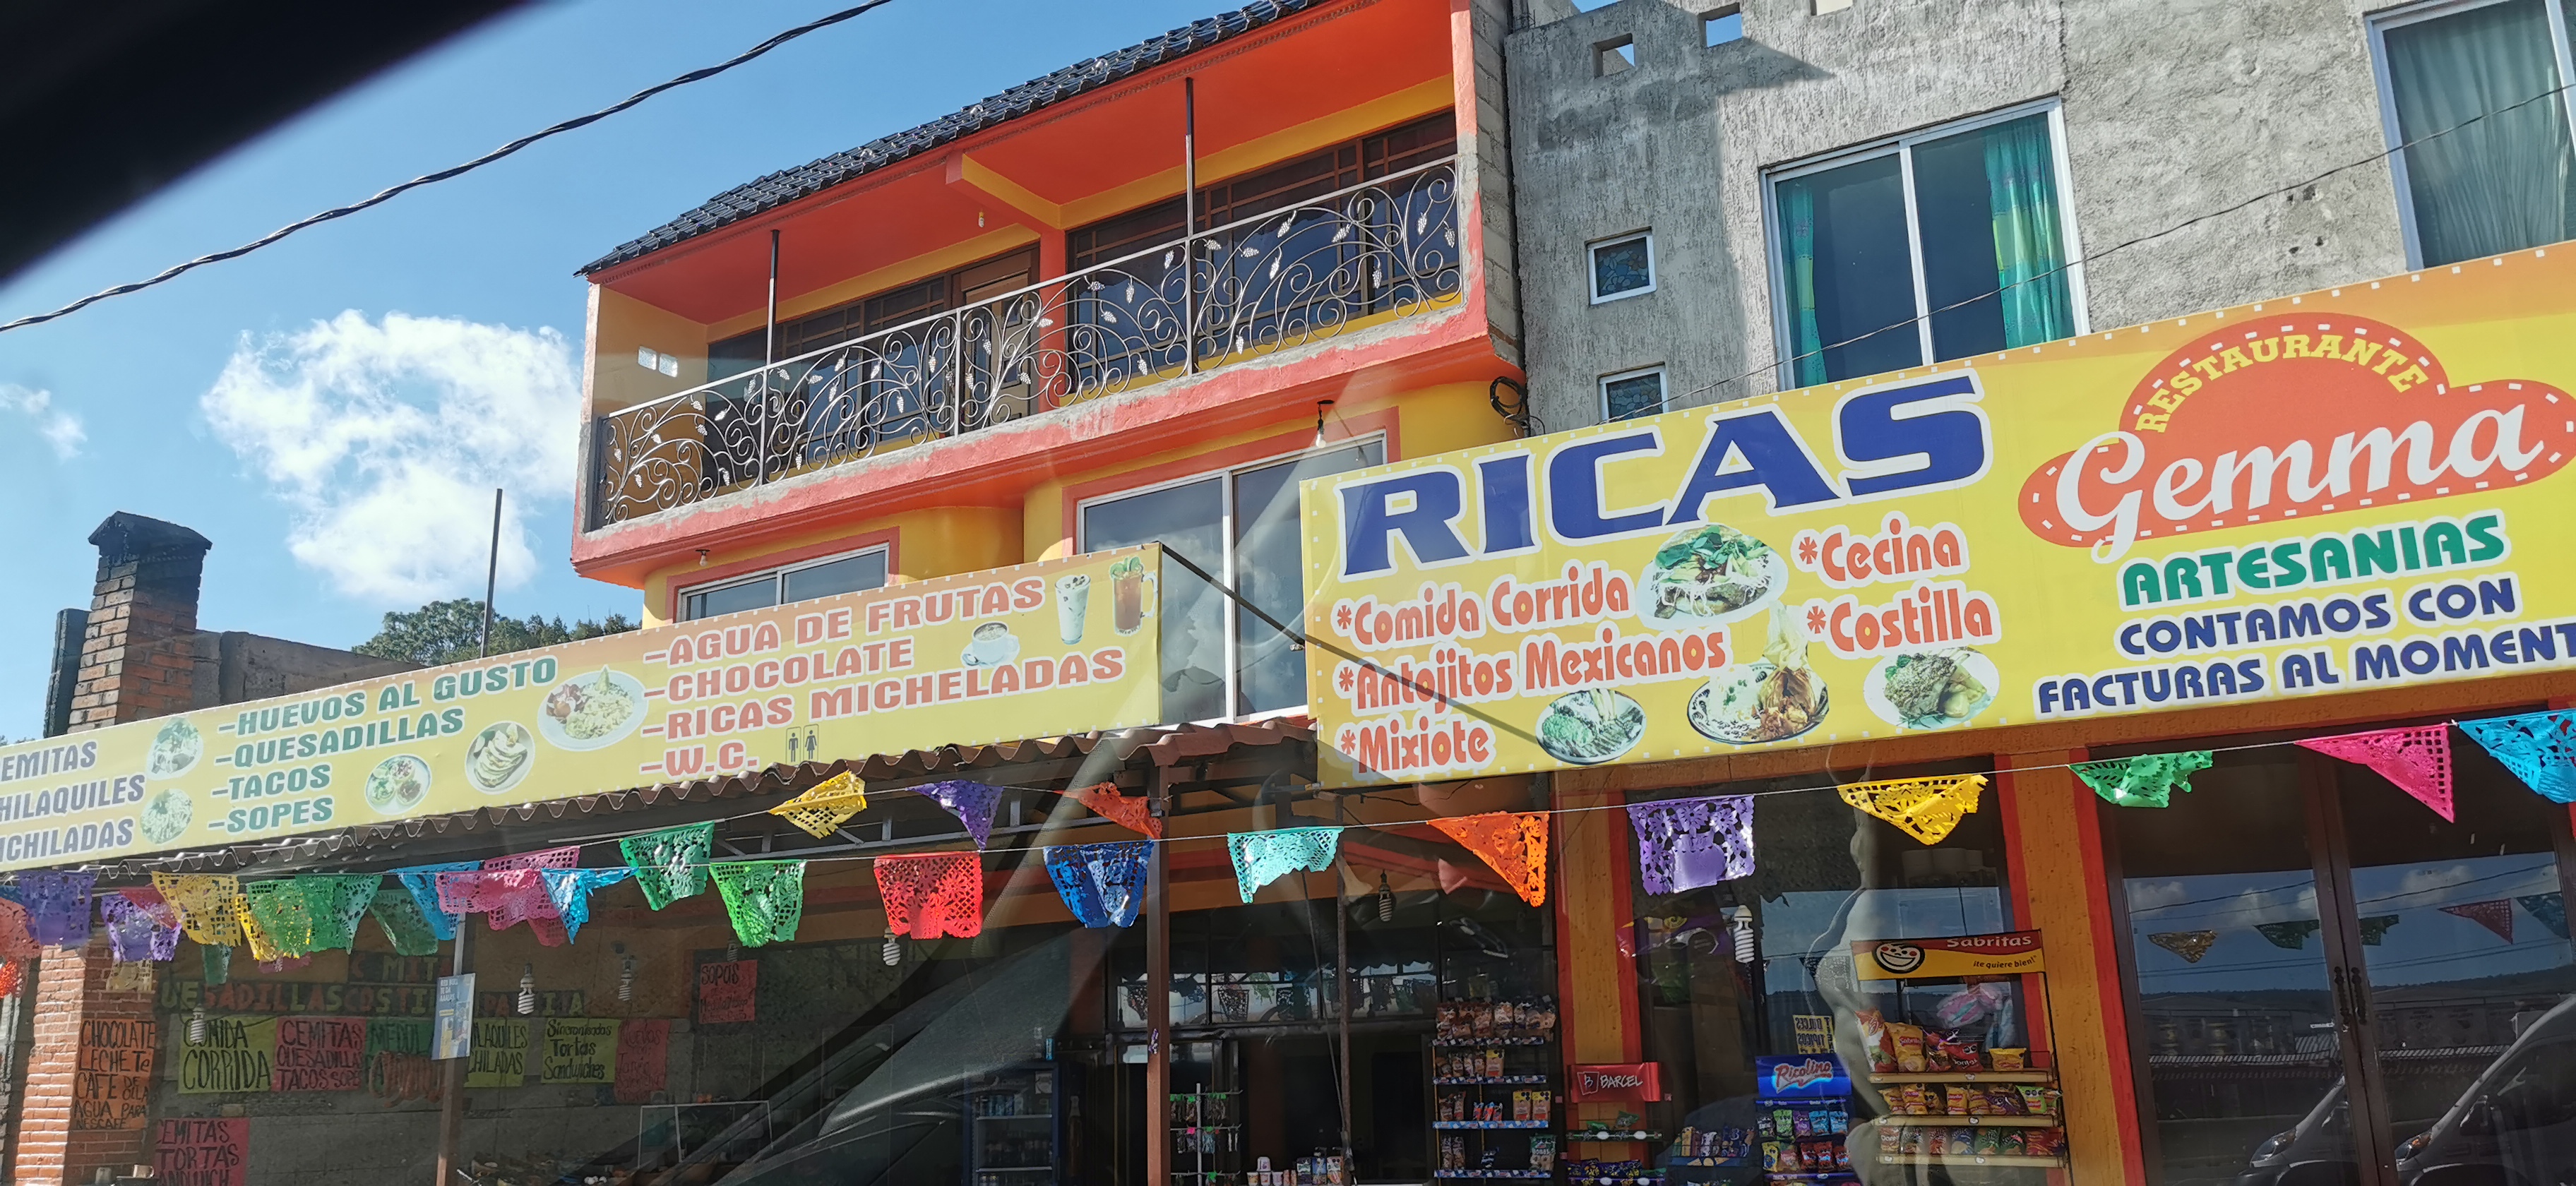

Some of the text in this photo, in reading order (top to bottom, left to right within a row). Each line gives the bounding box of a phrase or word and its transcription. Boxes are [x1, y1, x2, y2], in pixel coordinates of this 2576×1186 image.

[2135, 335, 2428, 433] RESTAURANTE
[1340, 376, 1985, 575] RICAS
[2056, 403, 2544, 563] Gemma
[2123, 515, 2505, 606] ARTESANIAS
[796, 609, 849, 645] DE
[866, 579, 1044, 633] FRUTAS
[1492, 570, 1630, 626] Corrida
[2121, 577, 2516, 655] CONTAMOS CON
[1525, 628, 1727, 689] Mexicanos
[378, 681, 421, 713] AL
[435, 655, 556, 702] GUSTO
[811, 649, 1124, 720] MICHELADAS
[2039, 659, 2262, 713] FACTURAS
[2283, 653, 2338, 689] AL
[1947, 935, 2032, 947] Sabritas
[1986, 961, 2014, 969] quiere
[80, 1021, 155, 1049] CHOCOLATE
[282, 1021, 362, 1050] CEMITAS
[549, 1038, 597, 1057] Tortas
[78, 1048, 131, 1072] LECHE
[183, 1050, 271, 1090] CORRIDA
[543, 1056, 605, 1080] Sandwiches
[1775, 1059, 1833, 1090] Ricolino
[123, 1076, 141, 1088] DE
[276, 1068, 329, 1091] TACOS
[1599, 1074, 1644, 1089] BARCEL
[73, 1100, 145, 1118] AGUA PARA
[155, 1144, 239, 1170] TORTAS
